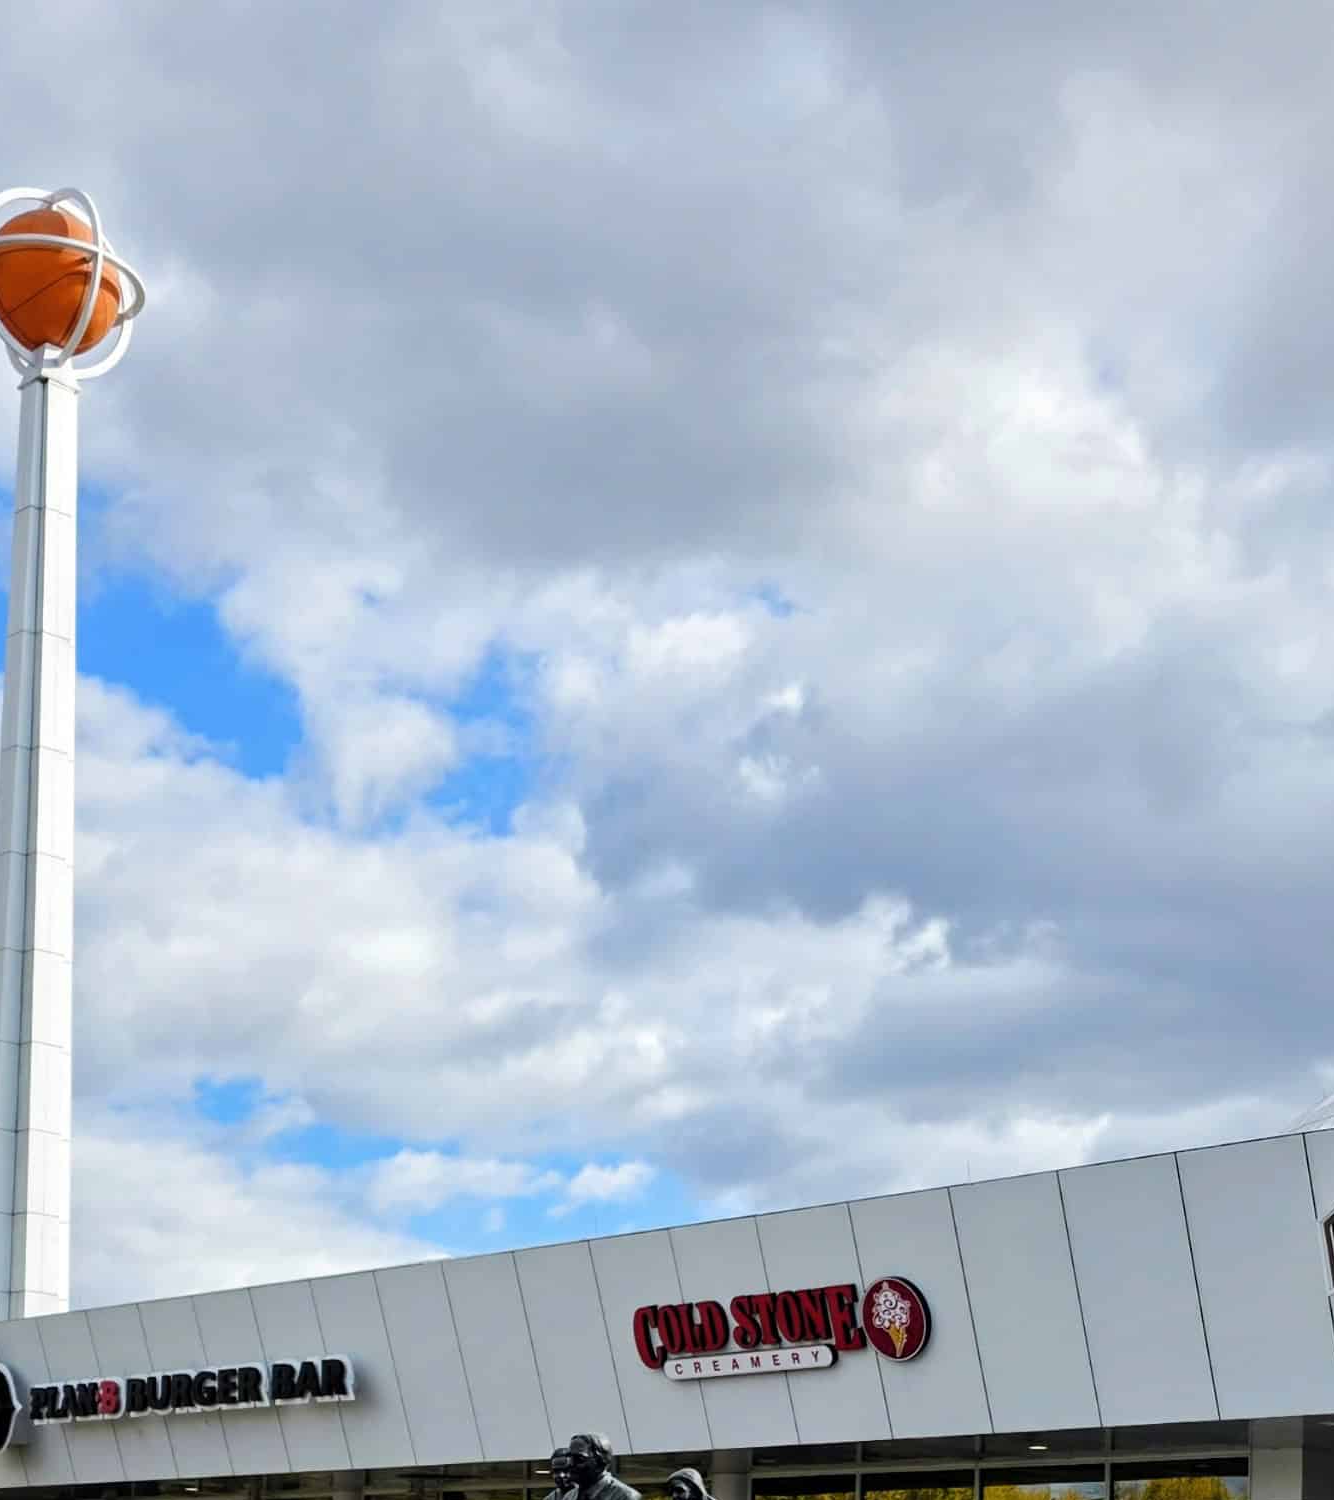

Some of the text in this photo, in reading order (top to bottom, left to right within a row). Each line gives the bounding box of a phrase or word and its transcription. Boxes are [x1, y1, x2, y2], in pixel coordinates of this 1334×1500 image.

[633, 1284, 867, 1370] COLD STONE
[126, 1366, 264, 1412] BURGER
[271, 1359, 348, 1399] BAR
[675, 1351, 821, 1375] CREAMERY
